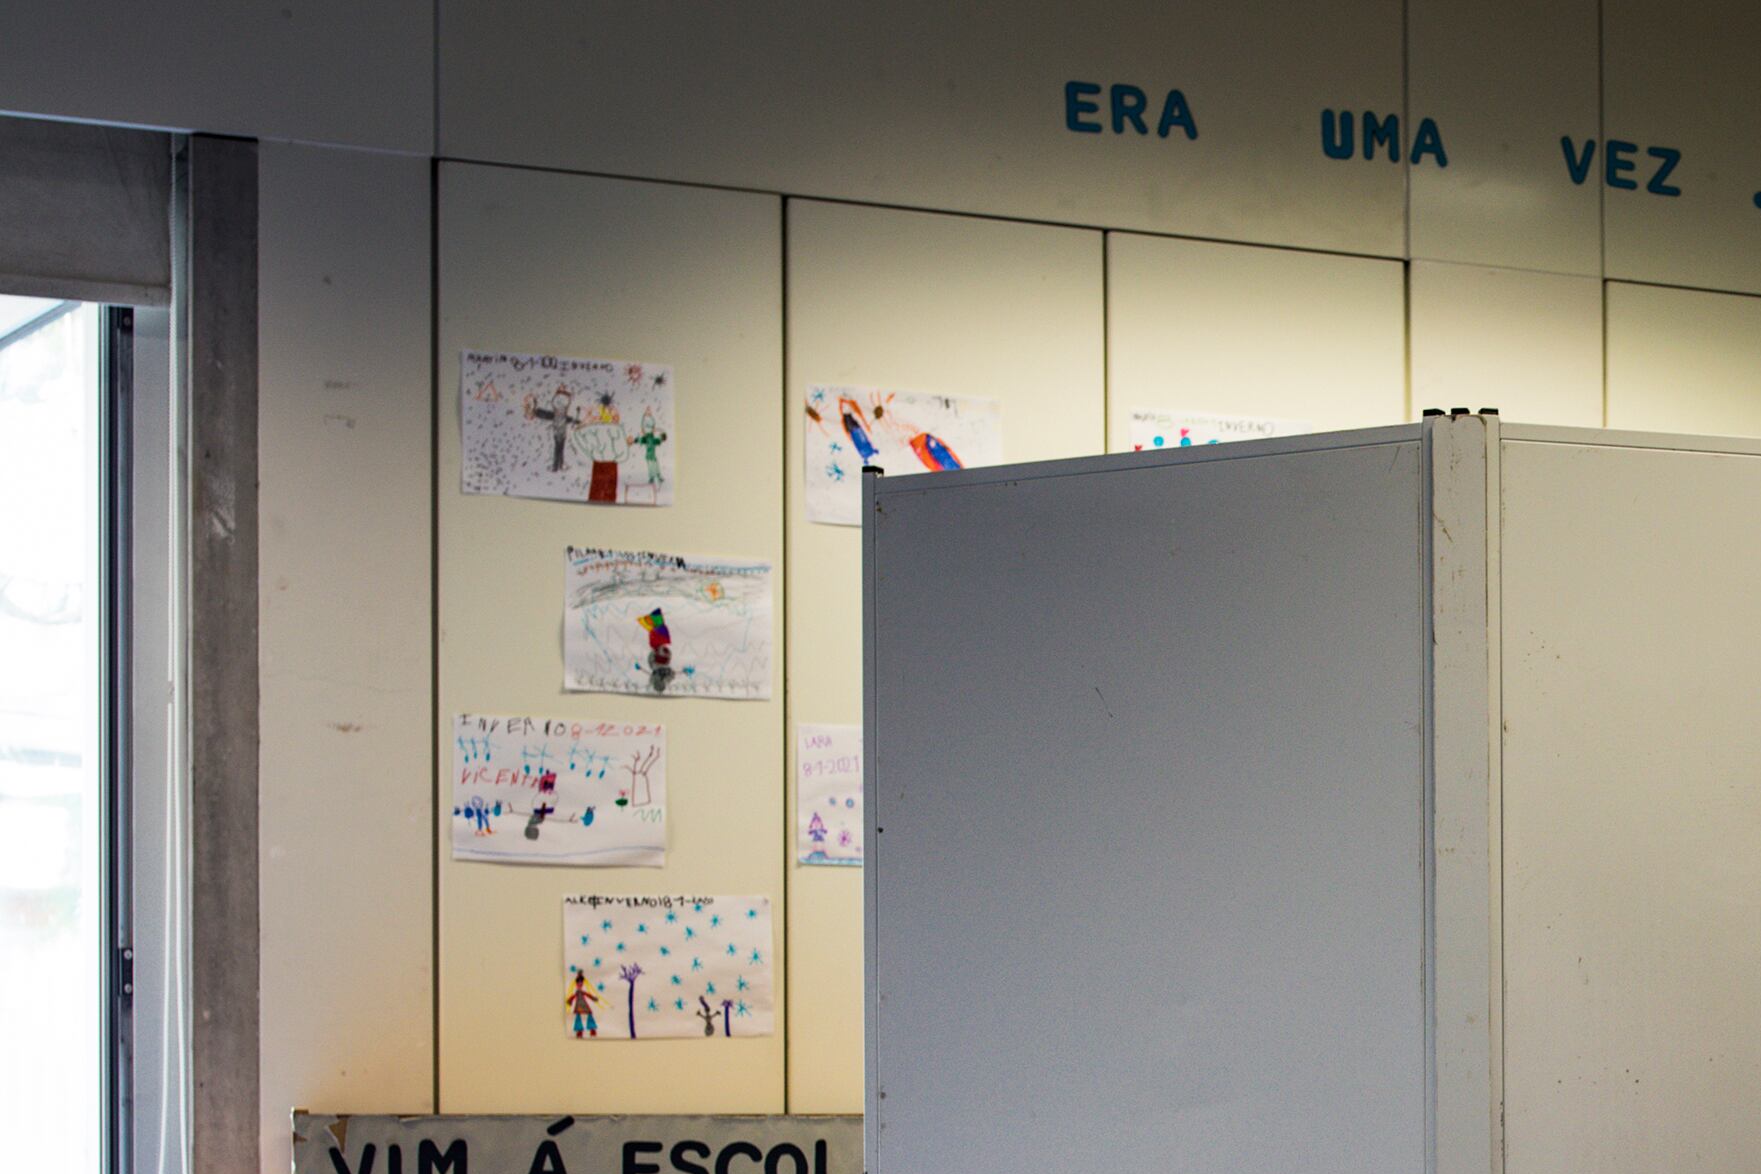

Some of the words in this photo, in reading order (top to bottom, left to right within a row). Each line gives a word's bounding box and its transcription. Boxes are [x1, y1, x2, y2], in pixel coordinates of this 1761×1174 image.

[1065, 81, 1198, 140] ERA
[1321, 109, 1448, 168] UMA
[1561, 136, 1682, 197] VEZ
